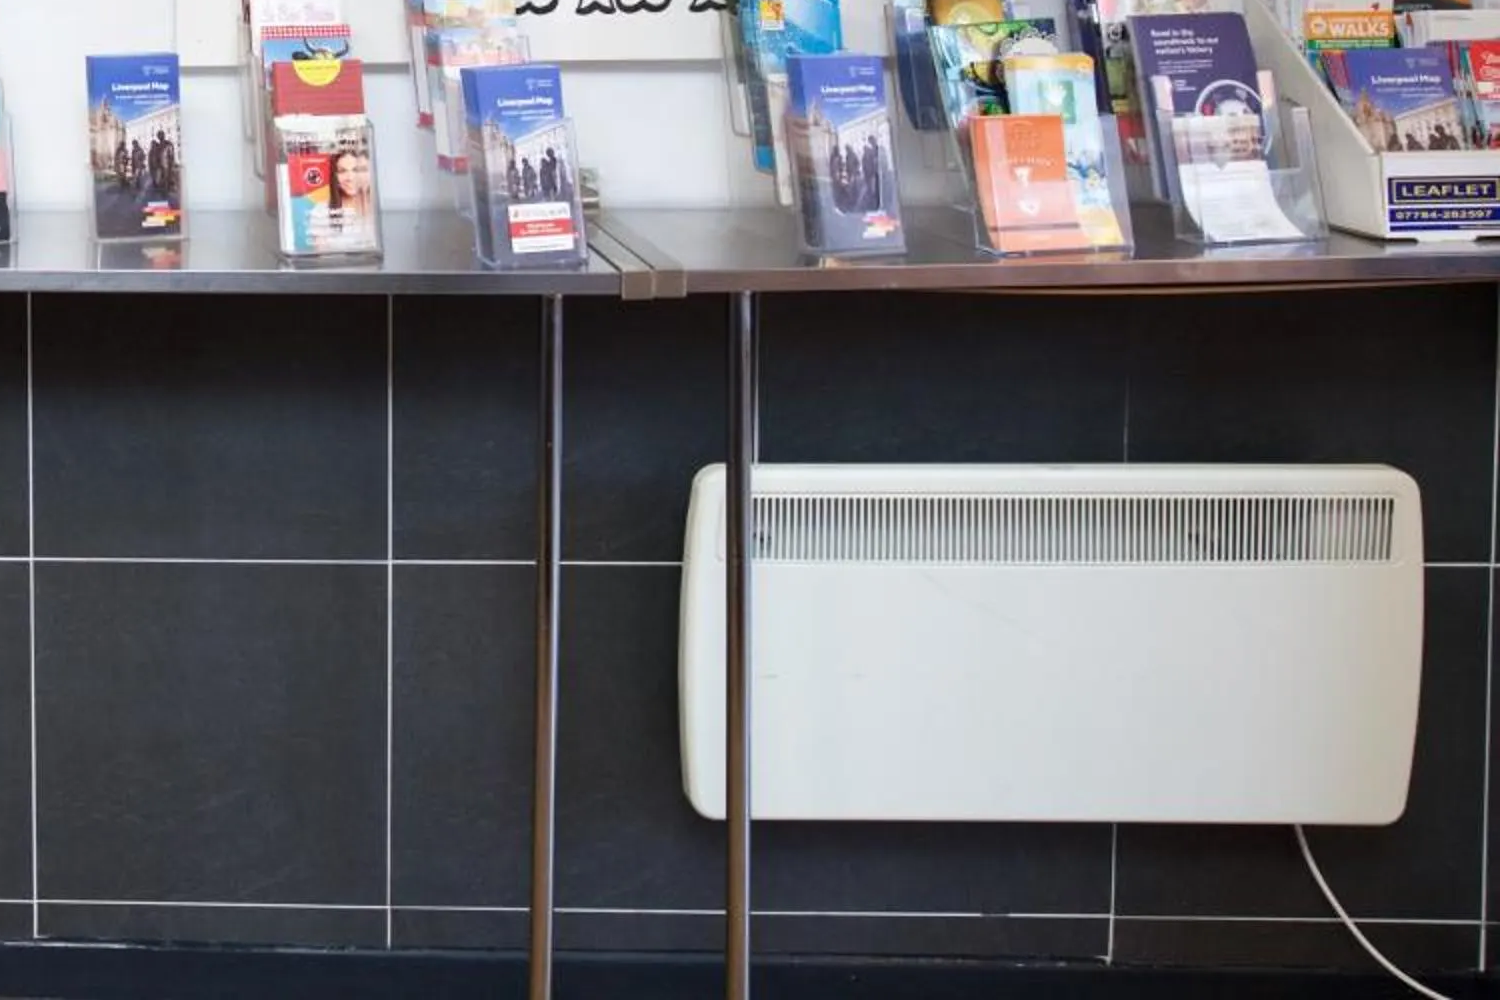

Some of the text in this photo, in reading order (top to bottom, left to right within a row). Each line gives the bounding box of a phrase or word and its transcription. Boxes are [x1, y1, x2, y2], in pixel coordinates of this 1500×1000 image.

[1328, 21, 1389, 38] WALKS
[1371, 74, 1441, 85] Liverpool Map
[111, 81, 170, 92] Liverpool Map
[821, 85, 876, 95] Liverpool Map
[497, 97, 553, 109] Liverpool Map
[1401, 183, 1491, 197] LEAFLET
